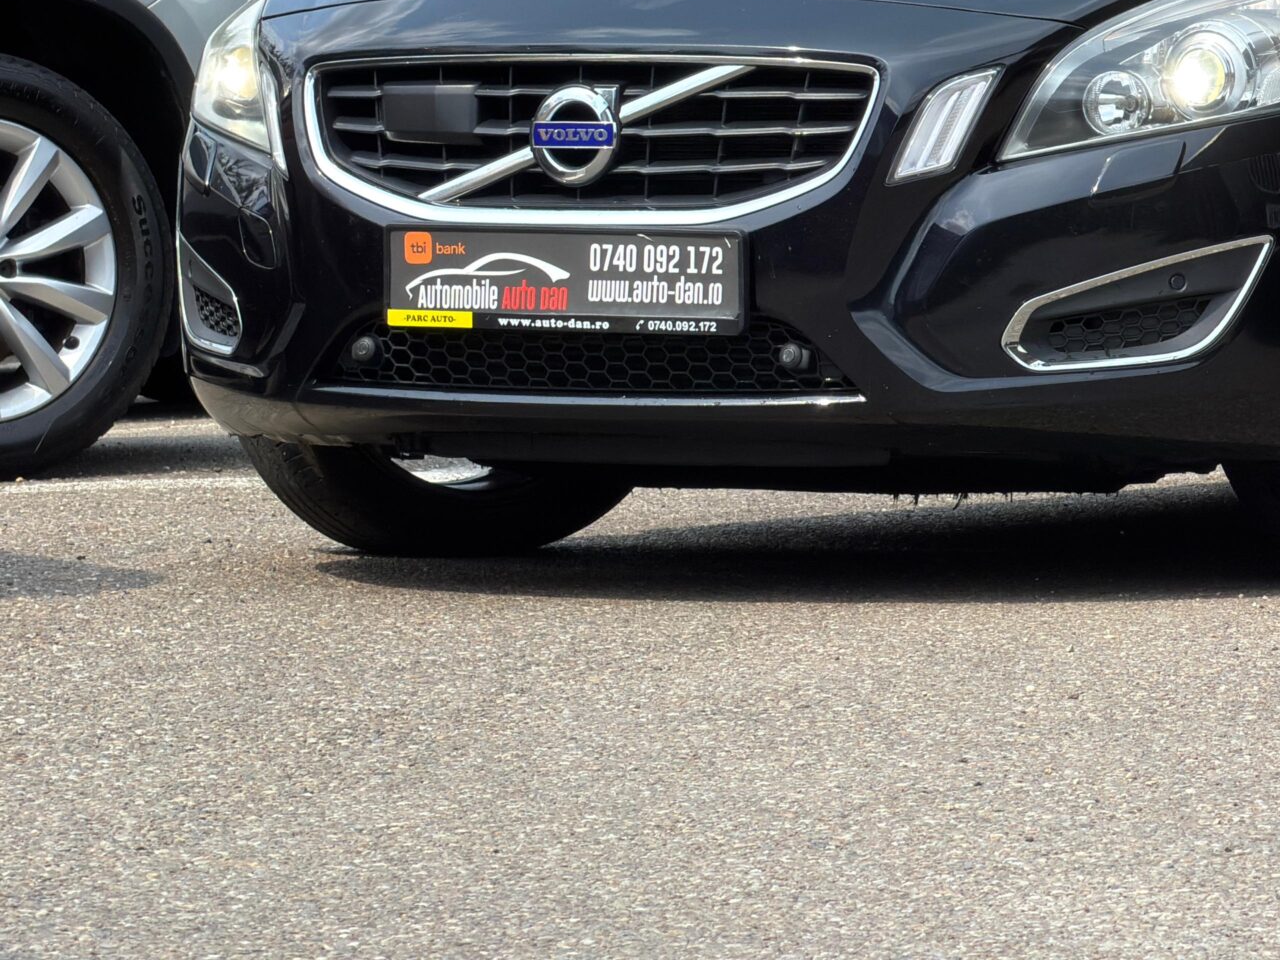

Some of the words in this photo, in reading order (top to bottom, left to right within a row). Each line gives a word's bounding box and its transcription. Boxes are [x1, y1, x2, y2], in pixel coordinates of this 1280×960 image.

[537, 127, 609, 142] VOLVO
[410, 241, 427, 255] tbi
[435, 242, 466, 256] bank
[589, 242, 637, 272] 0740
[643, 244, 680, 274] 092
[686, 245, 723, 275] 172
[417, 277, 498, 310] Automobile
[587, 274, 723, 306] www.auto-dan.ro
[497, 316, 610, 330] www.auto-dan.ro
[647, 320, 717, 332] 0740.092.172
